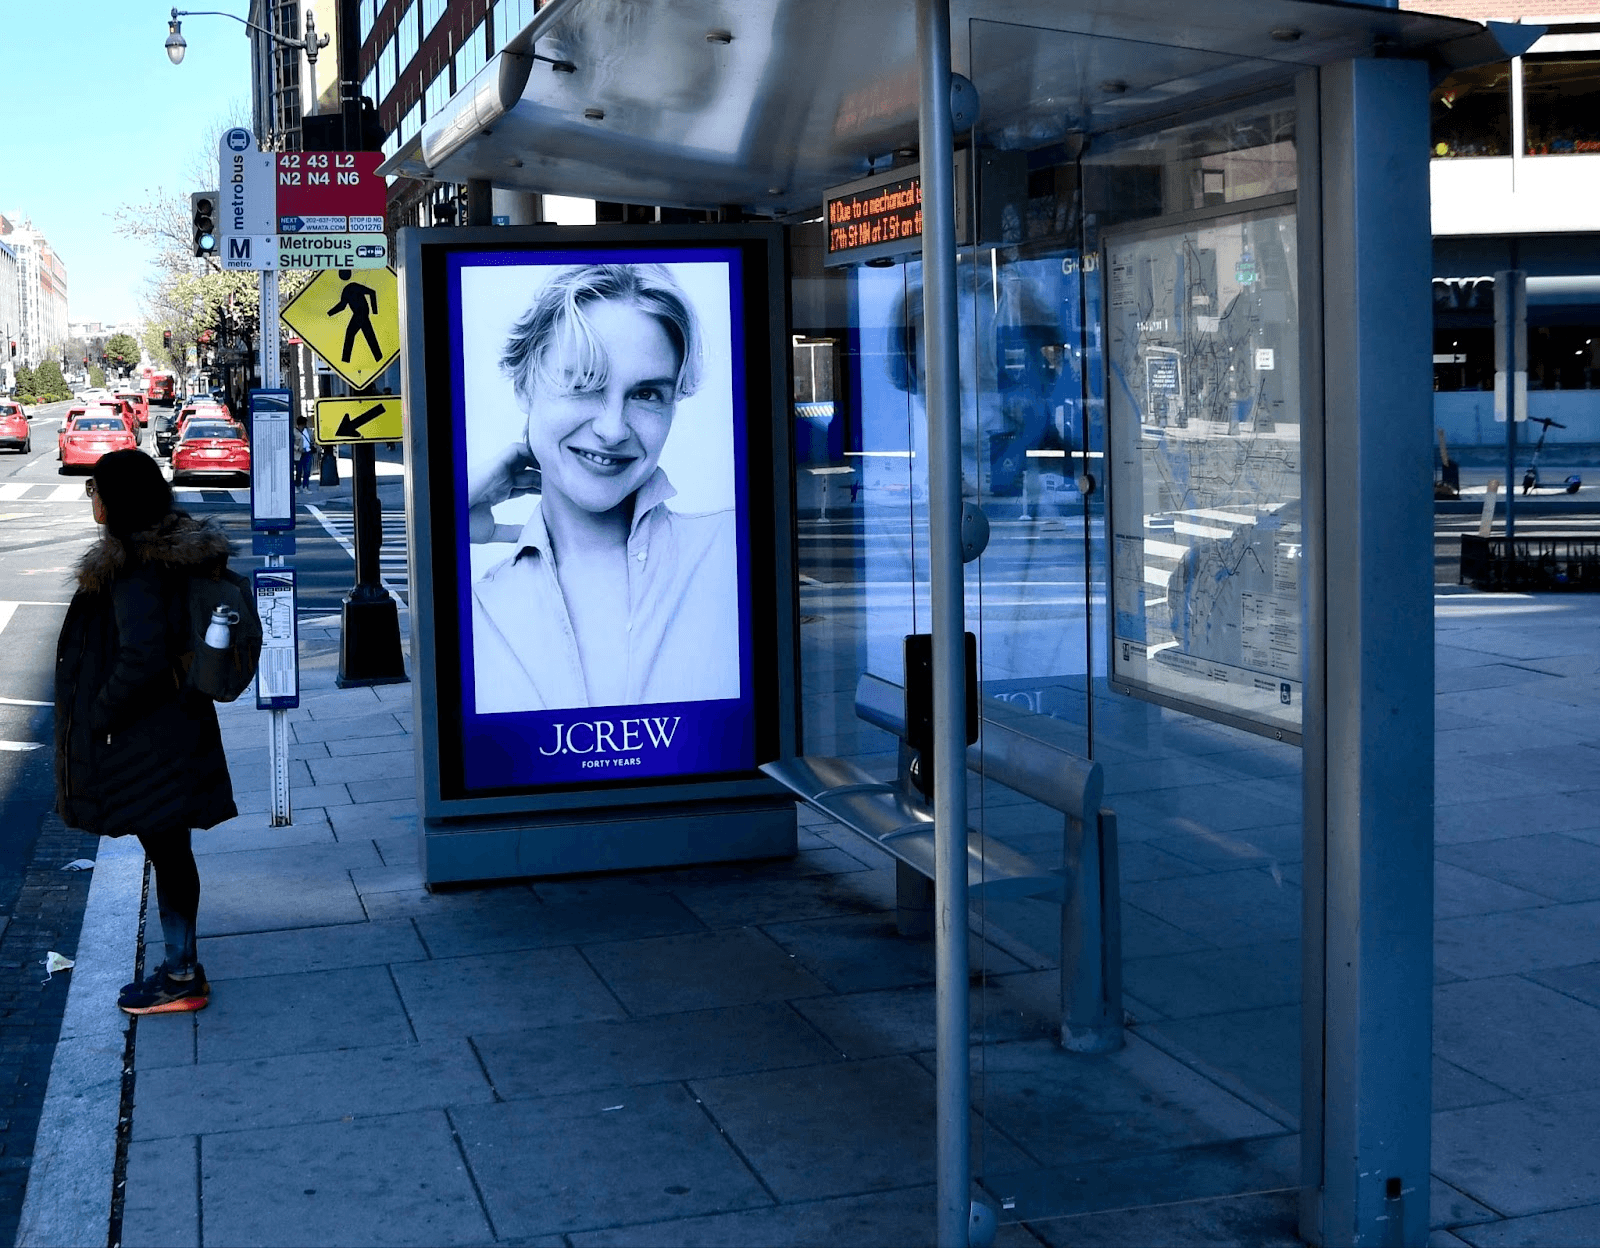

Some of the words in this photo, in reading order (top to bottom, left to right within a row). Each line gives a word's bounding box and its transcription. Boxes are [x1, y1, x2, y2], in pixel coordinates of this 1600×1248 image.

[279, 154, 301, 168] 42
[307, 154, 329, 168] 43
[335, 154, 355, 168] L2
[279, 172, 301, 185] N2
[308, 172, 330, 185] N4
[337, 172, 360, 185] N6
[231, 155, 244, 230] metrobus
[853, 197, 862, 218] to
[831, 227, 847, 251] 17th
[848, 224, 858, 247] St
[871, 218, 881, 243] at
[889, 214, 900, 239] St
[901, 219, 913, 237] on
[280, 237, 352, 249] Metrobus
[280, 254, 354, 267] SHUTTLE
[539, 716, 681, 756] J.CREW
[582, 760, 610, 768] FORTY
[613, 758, 642, 766] YEARS
